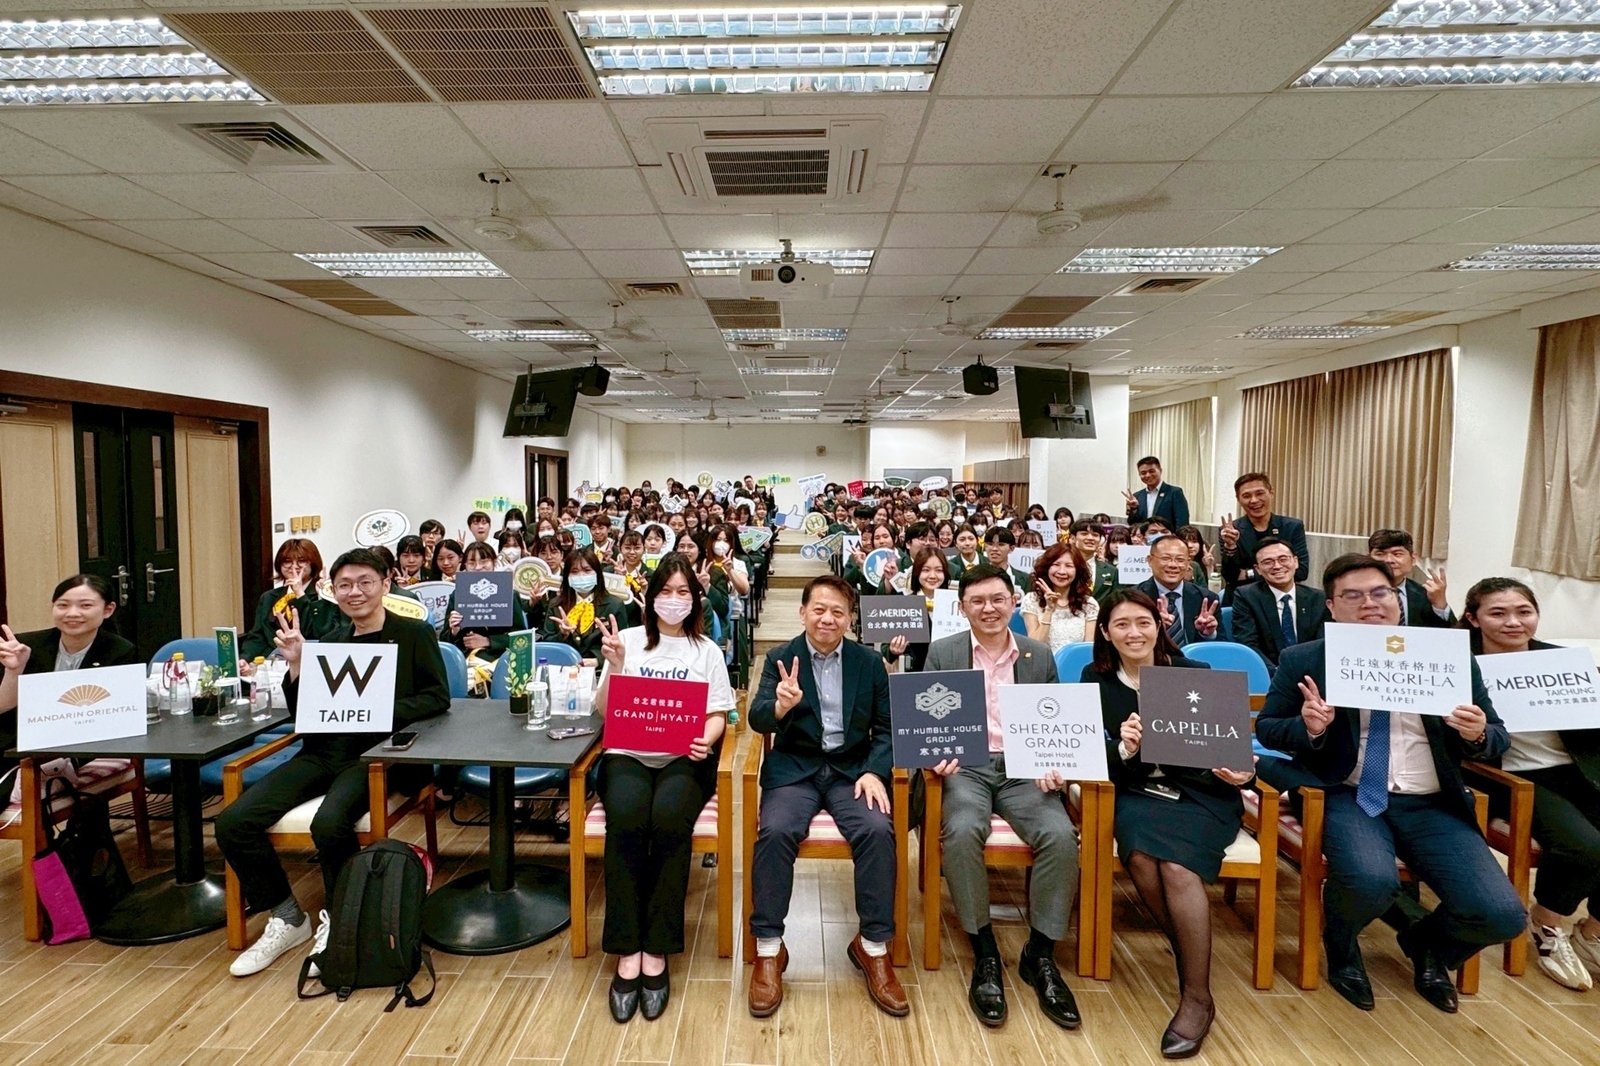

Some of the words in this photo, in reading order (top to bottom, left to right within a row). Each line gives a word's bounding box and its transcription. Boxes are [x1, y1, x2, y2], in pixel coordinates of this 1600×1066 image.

[436, 595, 448, 608] 好
[879, 608, 923, 617] MERIDIEN
[867, 621, 923, 629] 台北寒舍艾美酒店
[1340, 656, 1456, 674] 台北遠東香格里拉
[316, 654, 383, 698] W
[640, 667, 689, 680] World
[1340, 668, 1455, 688] SHANGRI-LA
[1496, 671, 1592, 691] MERIDIEN
[1360, 685, 1380, 693] FAR
[1386, 686, 1434, 697] EASTERN
[1545, 687, 1595, 696] TAICHUNG
[1381, 695, 1414, 704] TAIPEI
[28, 712, 84, 724] MANDARIN
[86, 705, 138, 717] ORIENTAL
[319, 709, 371, 722] TAIPEI
[614, 709, 654, 720] GRAND
[660, 712, 698, 723] HYATT
[913, 726, 950, 735] HUMBLE
[953, 725, 982, 733] HOUSE
[1009, 723, 1096, 734] SHERATON
[1151, 719, 1239, 739] CAPELLA
[925, 735, 957, 743] GROUP
[1025, 737, 1081, 748] GRAND
